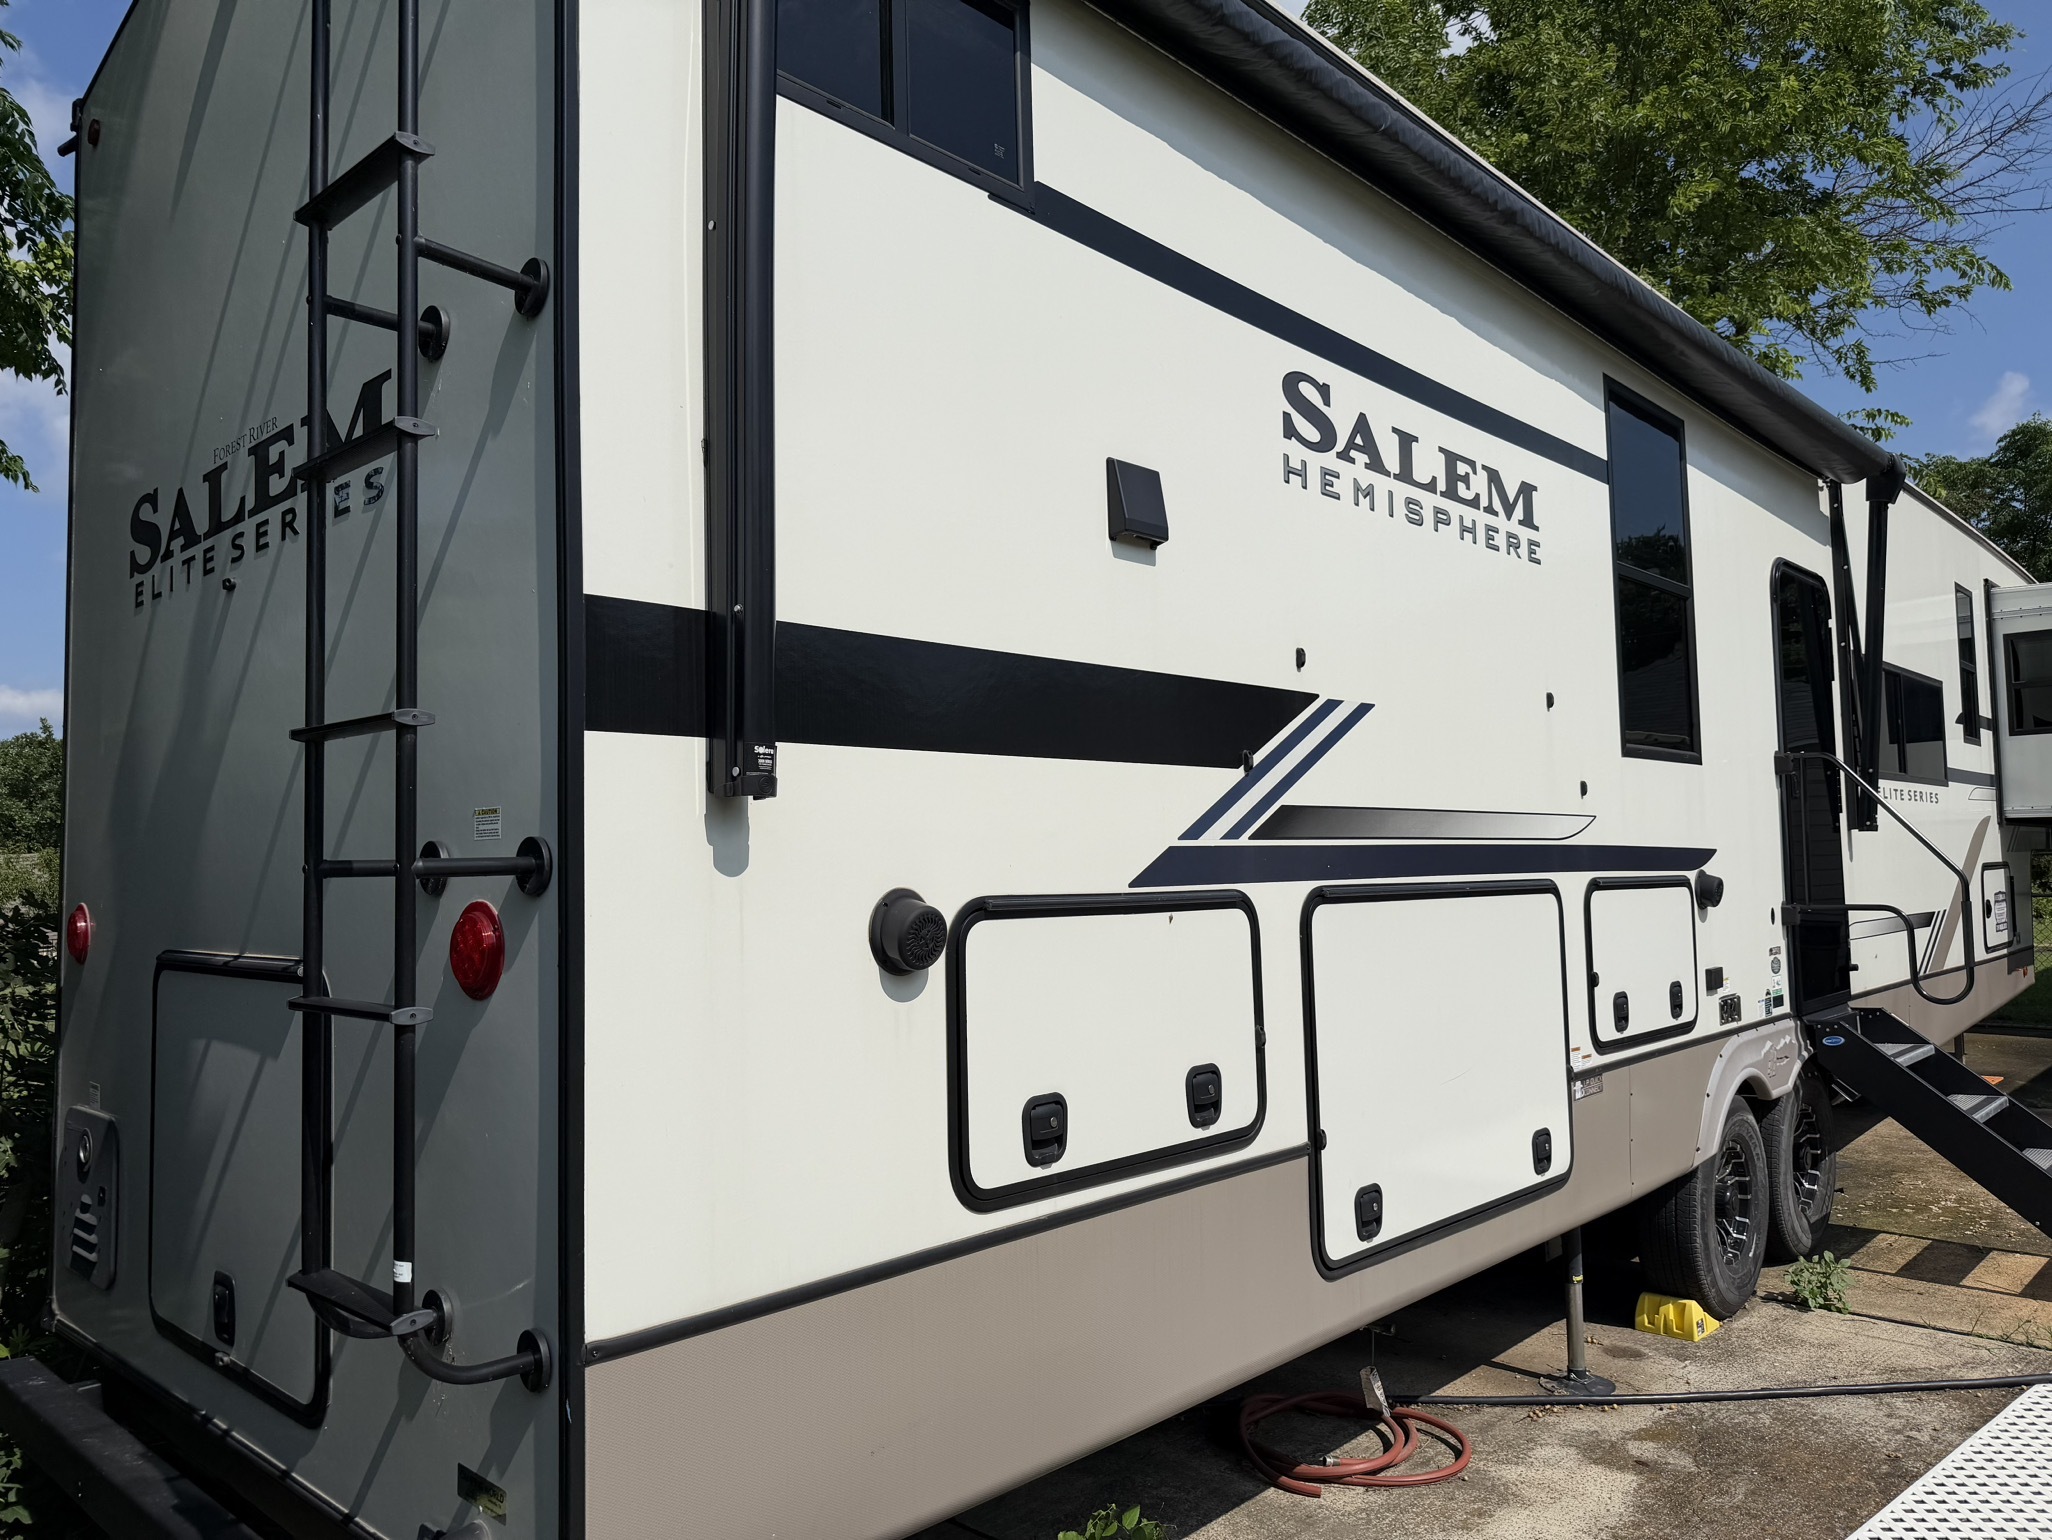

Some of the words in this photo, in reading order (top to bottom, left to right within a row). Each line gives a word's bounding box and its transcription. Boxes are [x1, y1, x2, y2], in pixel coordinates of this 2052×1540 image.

[213, 433, 247, 465] FOREST
[249, 416, 278, 444] RIVER
[1282, 370, 1540, 532] SALEM
[135, 544, 216, 609] ELITE
[230, 466, 385, 564] SERES
[1282, 452, 1542, 566] HEMISPHERE
[1907, 789, 1939, 804] SERIES
